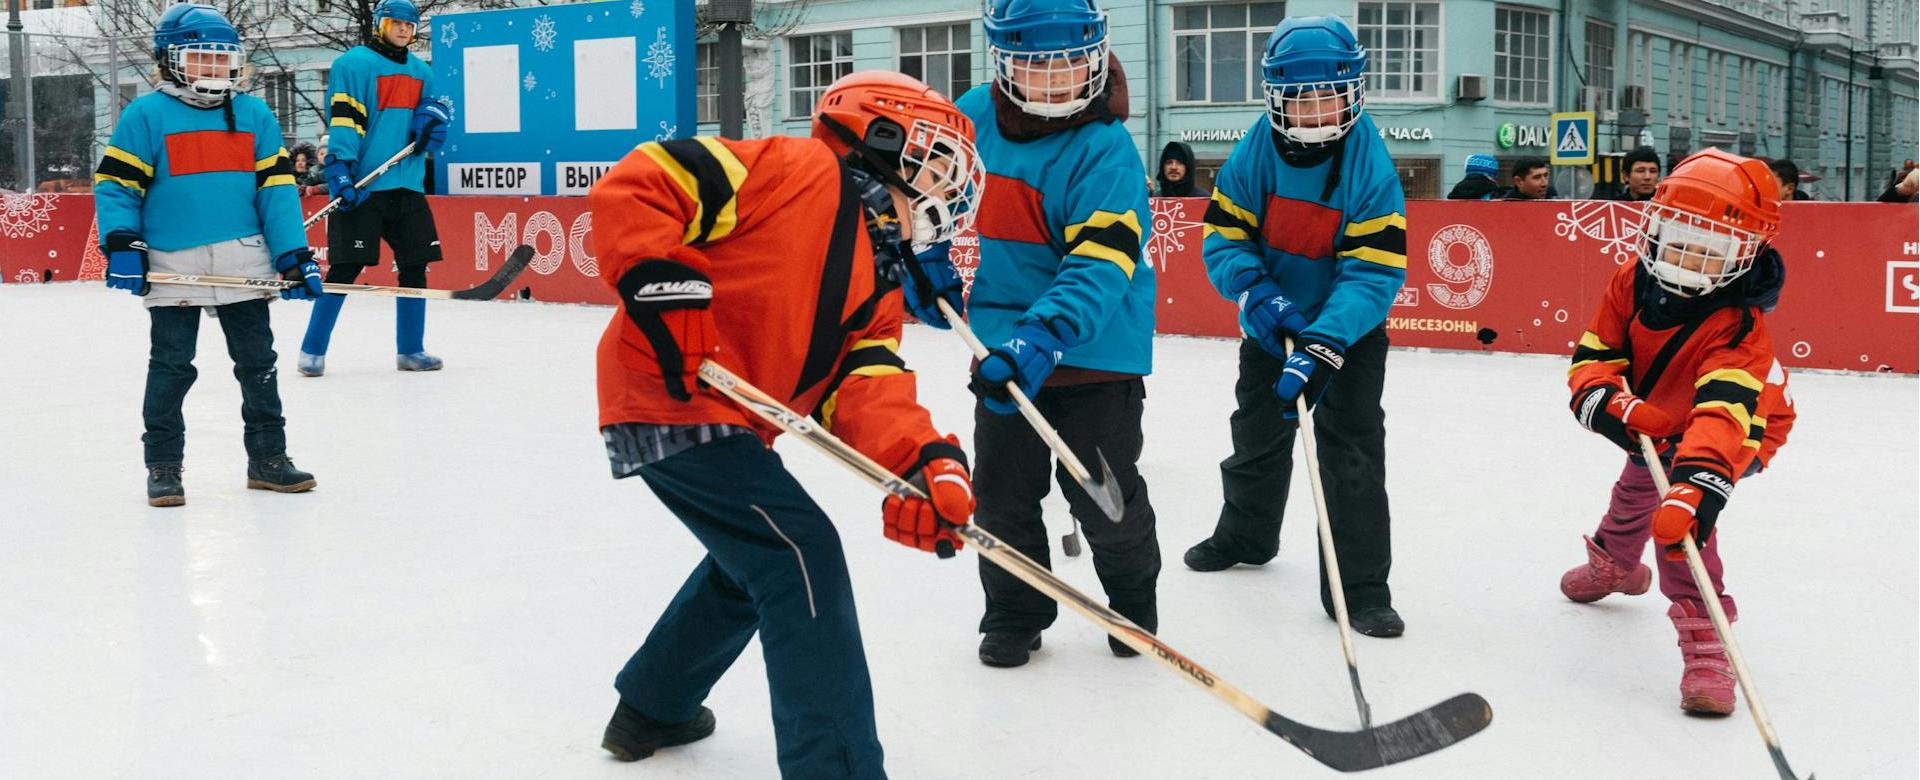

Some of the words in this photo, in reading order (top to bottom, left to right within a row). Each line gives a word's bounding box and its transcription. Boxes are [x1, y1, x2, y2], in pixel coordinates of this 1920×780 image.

[1389, 127, 1433, 140] ЧАСА
[1518, 125, 1553, 147] DAILY
[461, 167, 527, 189] МЕТЕОР
[1393, 223, 1494, 310] 9
[1151, 642, 1215, 688] TORNADO
